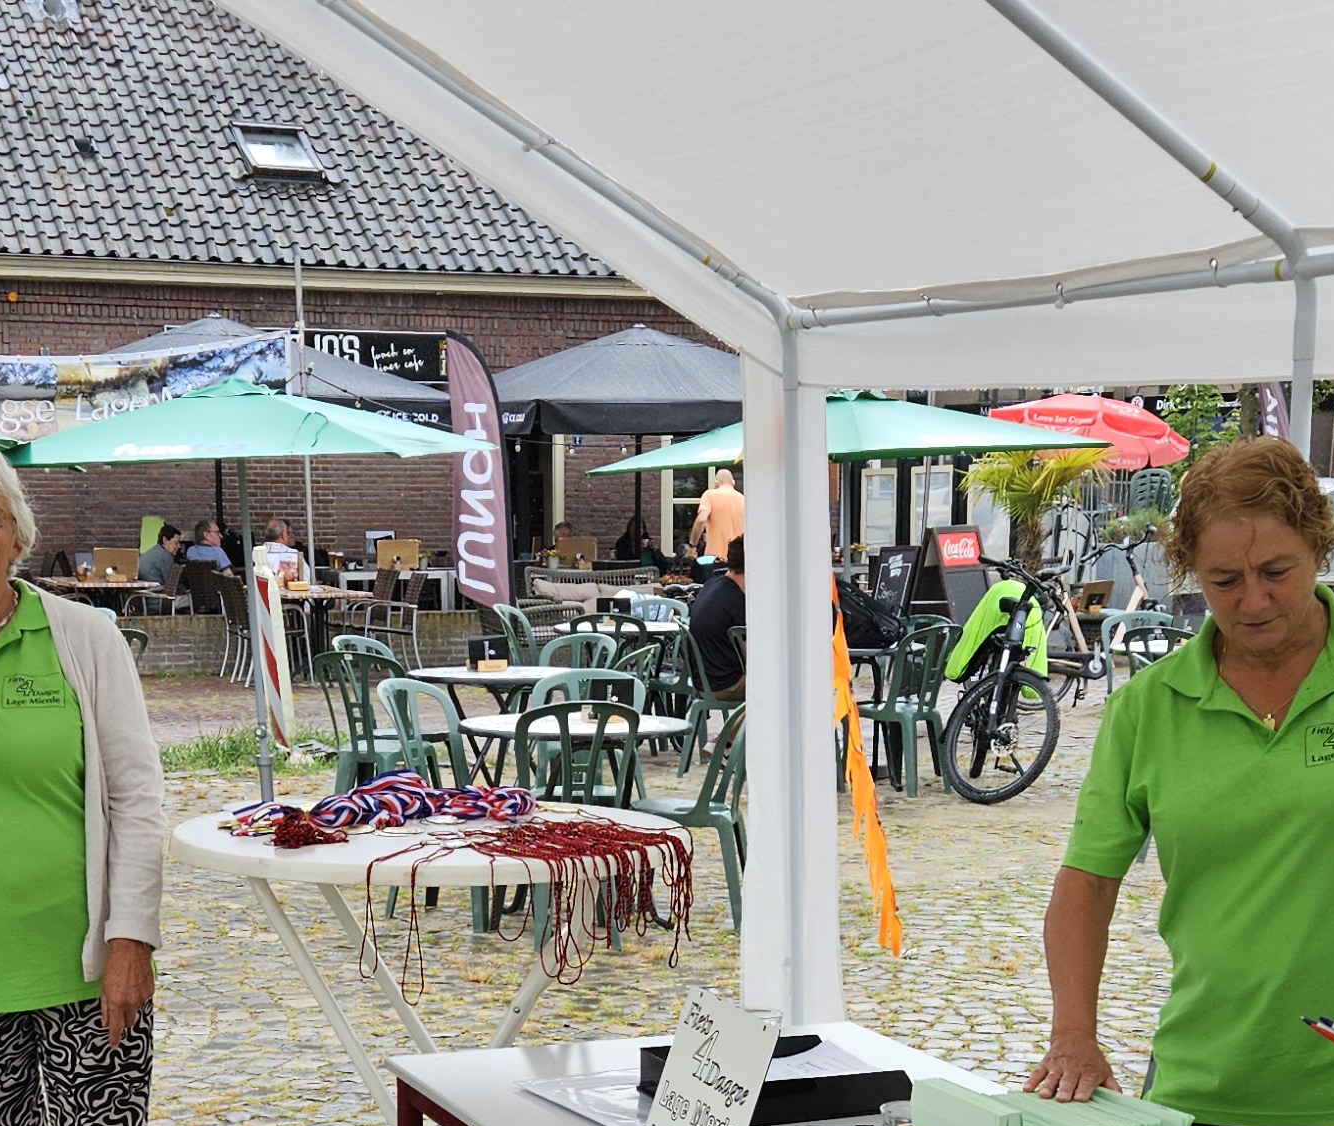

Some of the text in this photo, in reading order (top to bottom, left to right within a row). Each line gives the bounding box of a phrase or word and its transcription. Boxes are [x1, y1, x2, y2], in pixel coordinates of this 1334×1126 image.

[456, 402, 497, 594] LUNCH
[683, 1001, 715, 1036] Fiets
[692, 1029, 751, 1109] 4 Daagse
[657, 1079, 692, 1122] Lage
